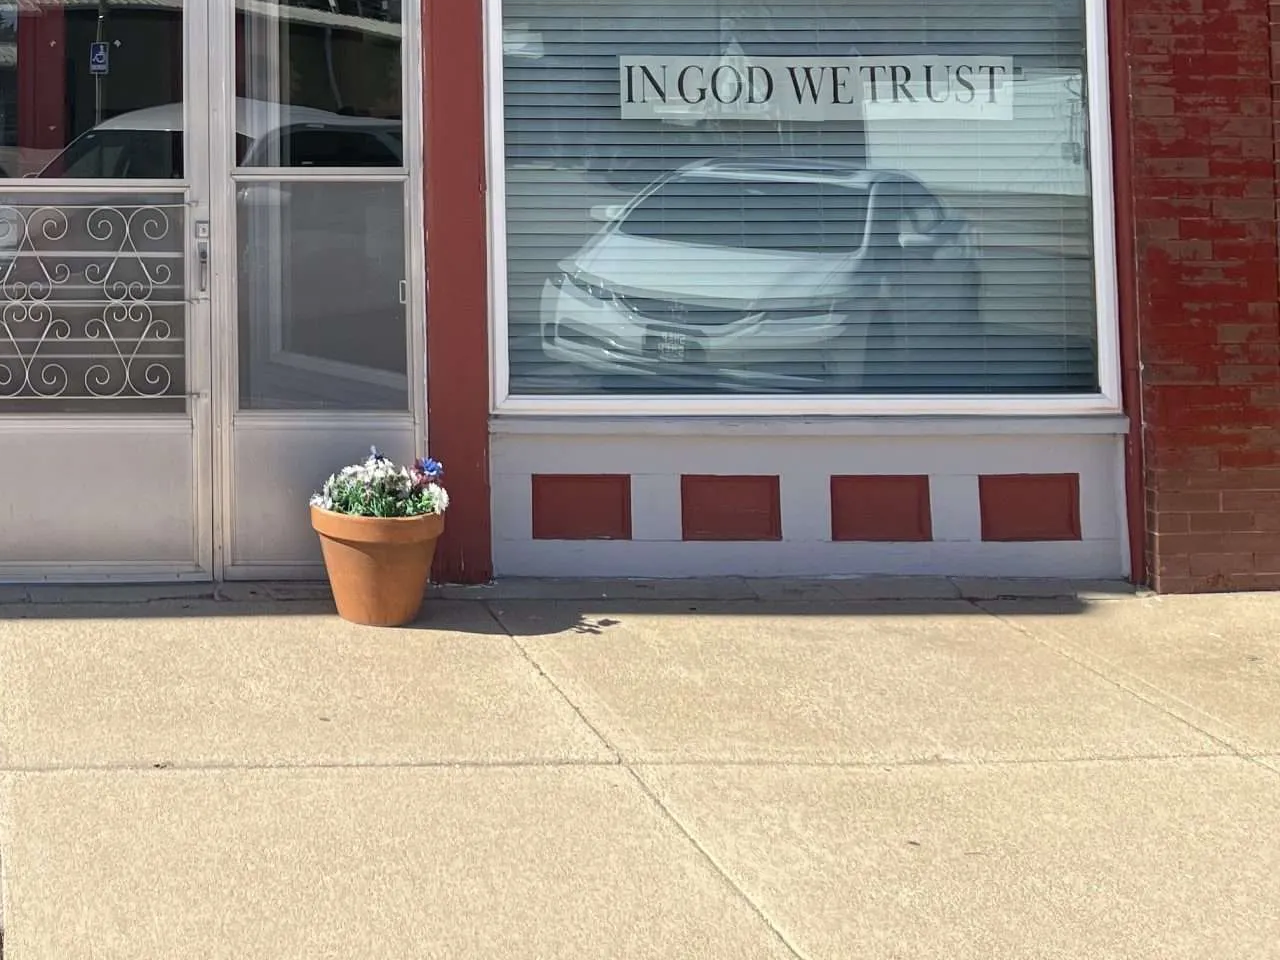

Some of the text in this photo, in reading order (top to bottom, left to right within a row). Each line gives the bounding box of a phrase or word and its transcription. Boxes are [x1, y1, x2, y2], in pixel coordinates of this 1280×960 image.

[625, 64, 1007, 105] IN GOD WE TRUST
